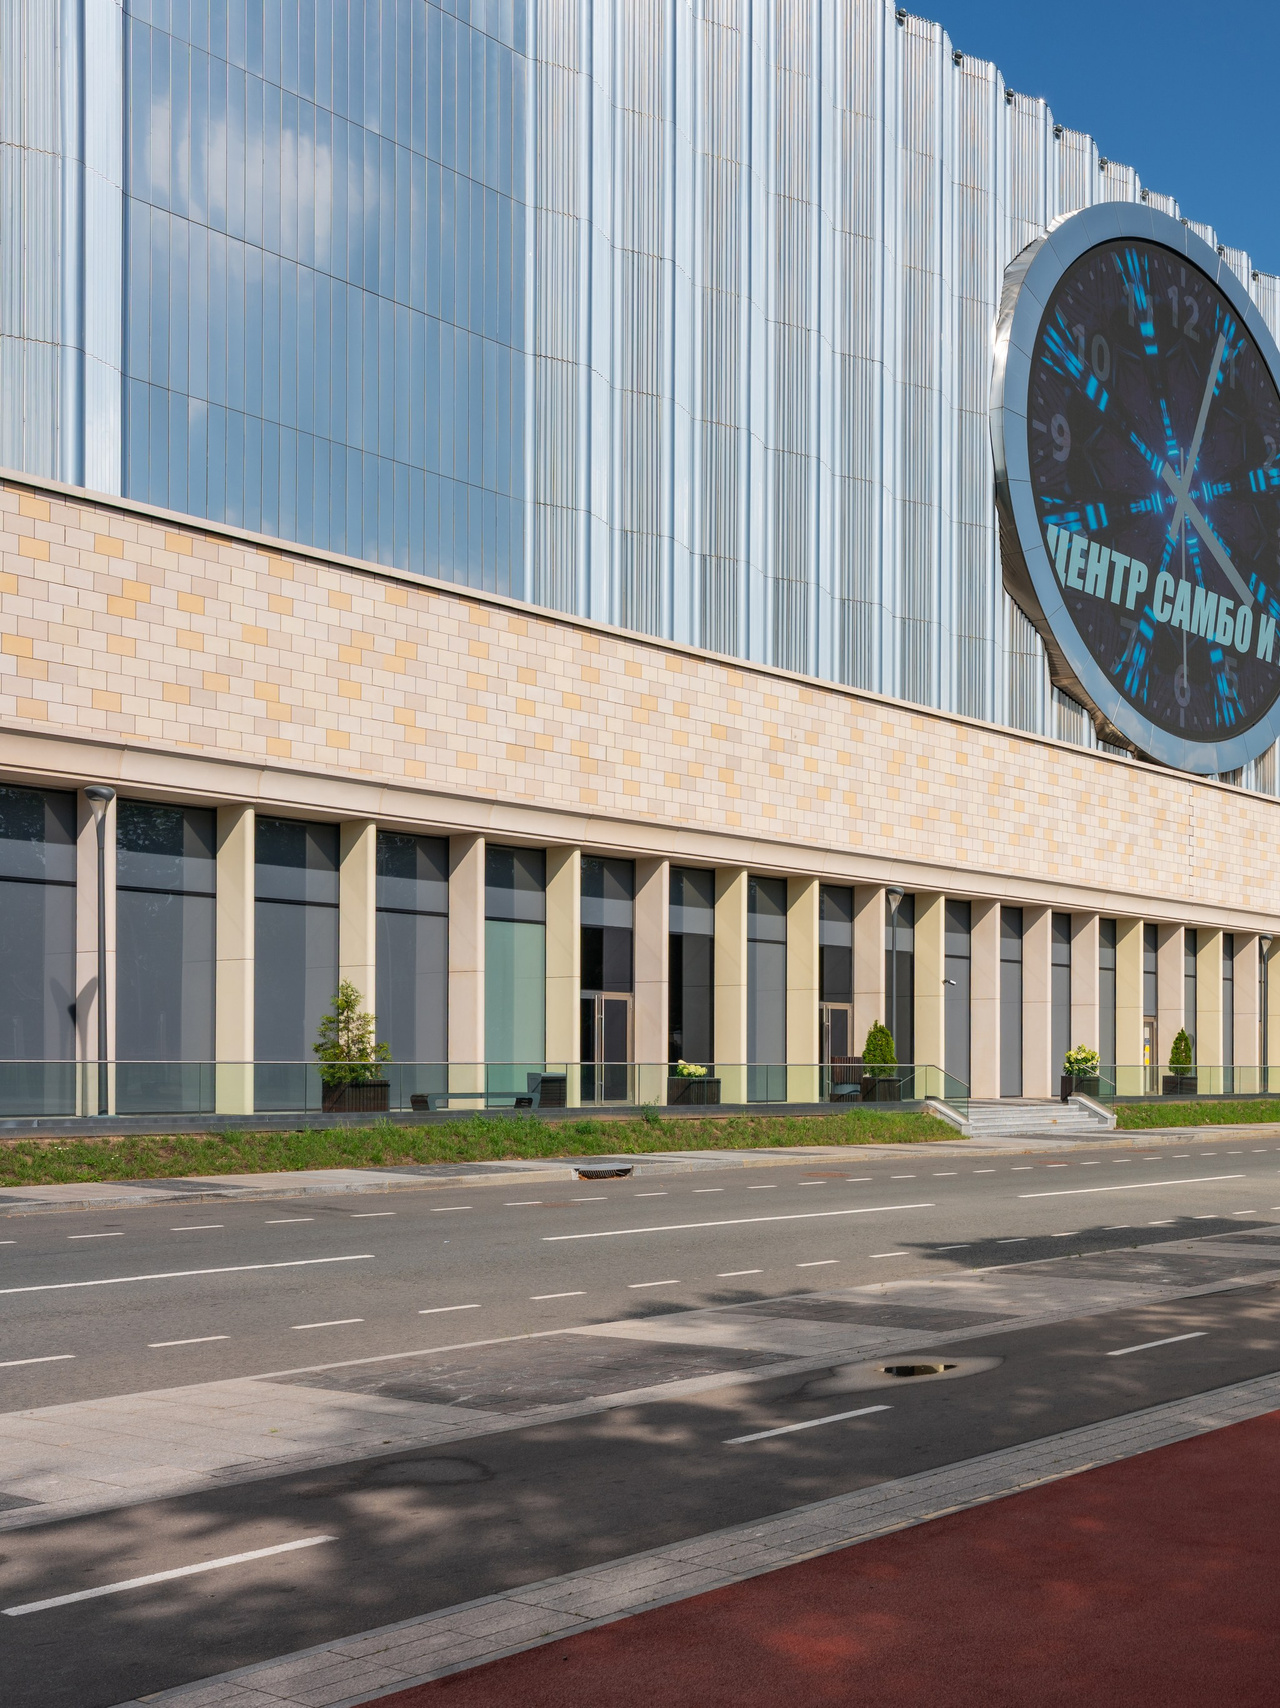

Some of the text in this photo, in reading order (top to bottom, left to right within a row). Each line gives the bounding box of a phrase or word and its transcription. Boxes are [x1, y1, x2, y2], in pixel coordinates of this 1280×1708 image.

[1168, 285, 1200, 343] 12
[1072, 323, 1110, 381] 10
[1051, 413, 1071, 462] 9
[1047, 523, 1149, 611] ЦЕНТР
[1153, 571, 1254, 654] САМБО
[1256, 613, 1277, 664] И
[1120, 616, 1139, 662] 7
[1174, 664, 1191, 707] 6
